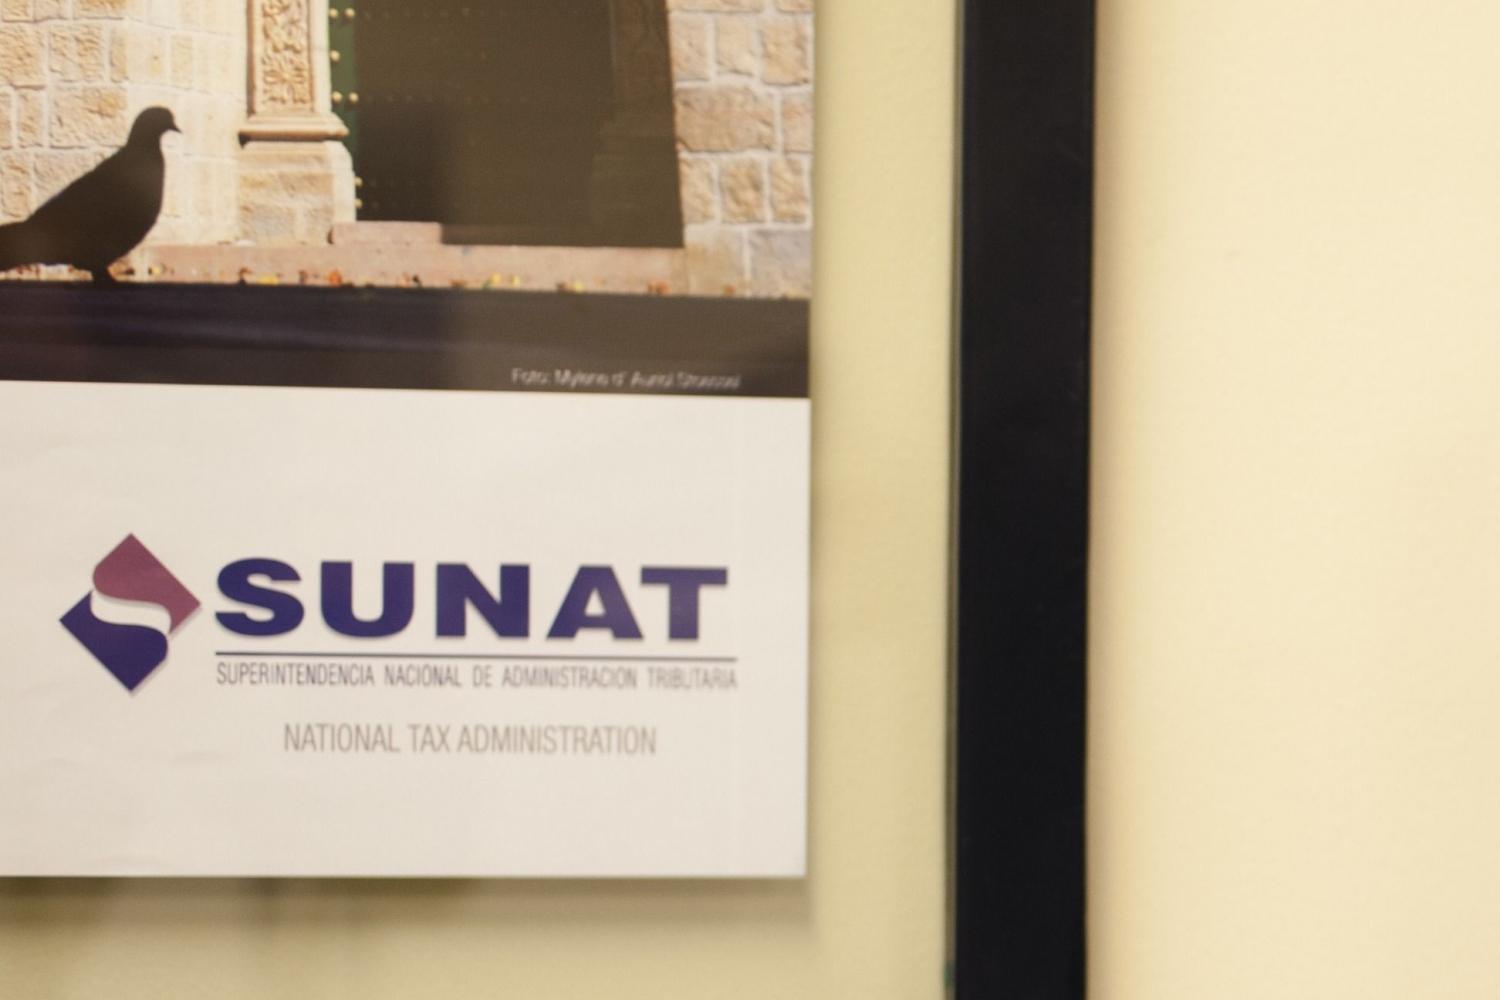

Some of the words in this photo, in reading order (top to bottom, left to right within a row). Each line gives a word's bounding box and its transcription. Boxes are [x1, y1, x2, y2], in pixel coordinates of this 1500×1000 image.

[215, 556, 728, 643] SUNAT
[216, 661, 375, 687] SUPERINTENDENCIA
[384, 663, 462, 688] NACIONAL
[472, 664, 492, 688] DE
[647, 666, 737, 689] TRIBUTARIA
[283, 722, 400, 753] NATIONAL
[408, 724, 450, 754] TAX
[457, 724, 658, 756] ADMINISTRATION
